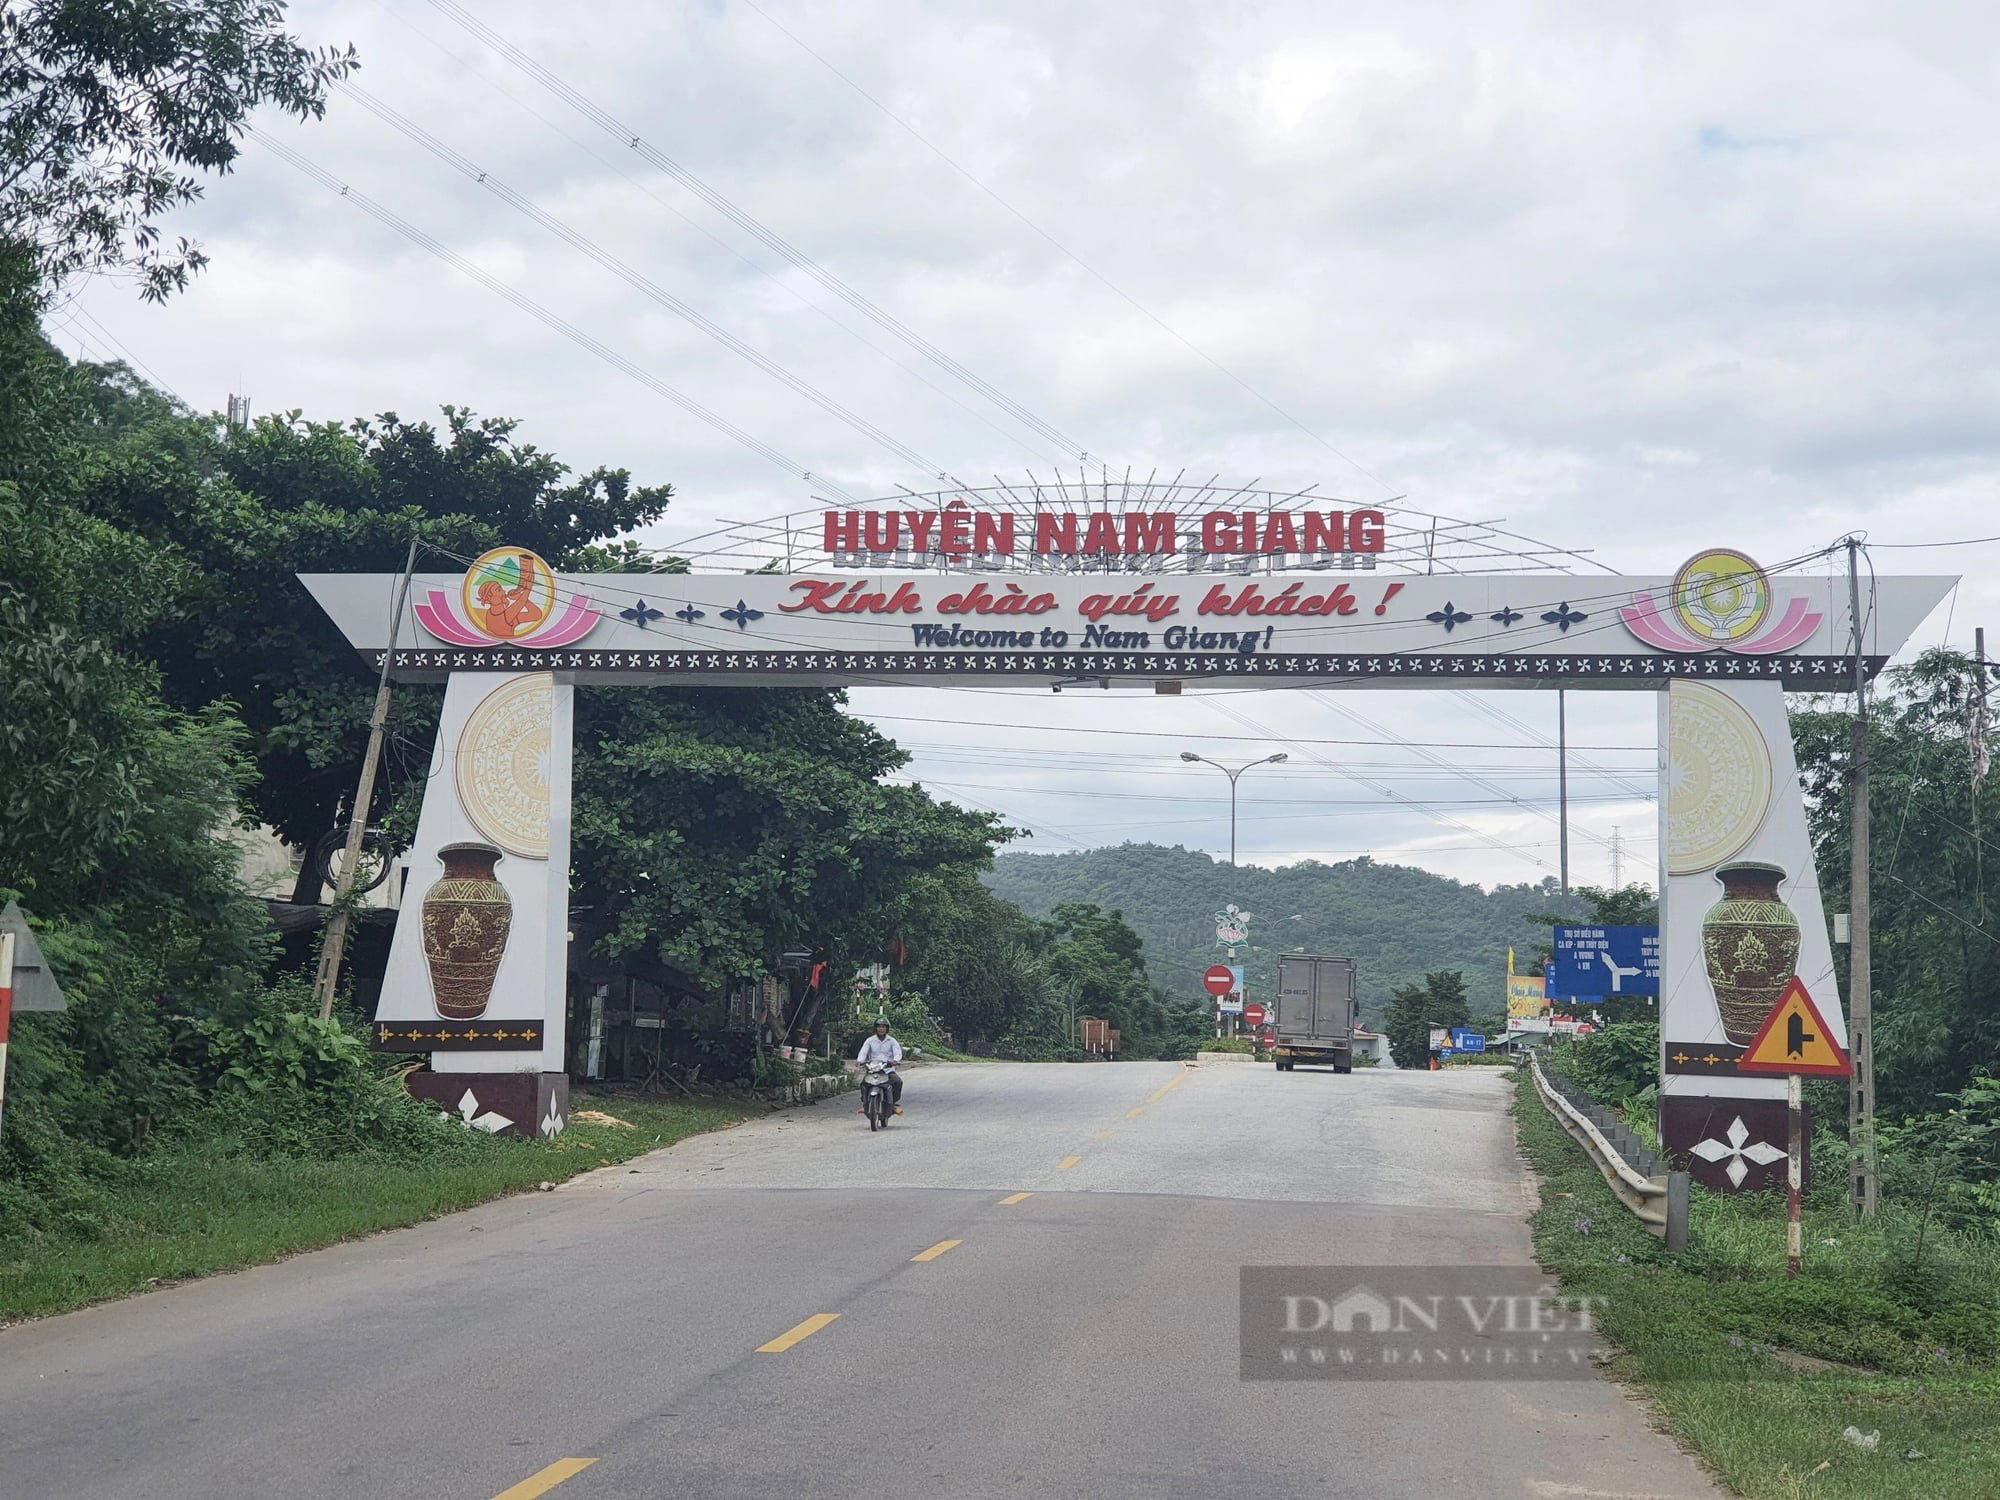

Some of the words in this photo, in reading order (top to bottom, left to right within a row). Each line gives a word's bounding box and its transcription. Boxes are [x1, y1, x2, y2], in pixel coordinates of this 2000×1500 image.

[824, 501, 1014, 563] HUYỆN
[1037, 512, 1176, 554] NAM
[1202, 510, 1385, 554] GIANG
[778, 580, 923, 614] Kính
[937, 582, 1059, 615] chào
[1198, 582, 1358, 616] khách
[1374, 583, 1405, 616] !
[911, 623, 1034, 648] Welcome
[1040, 627, 1068, 648] to
[1080, 624, 1150, 649] Nam
[1164, 624, 1274, 653] Giang!
